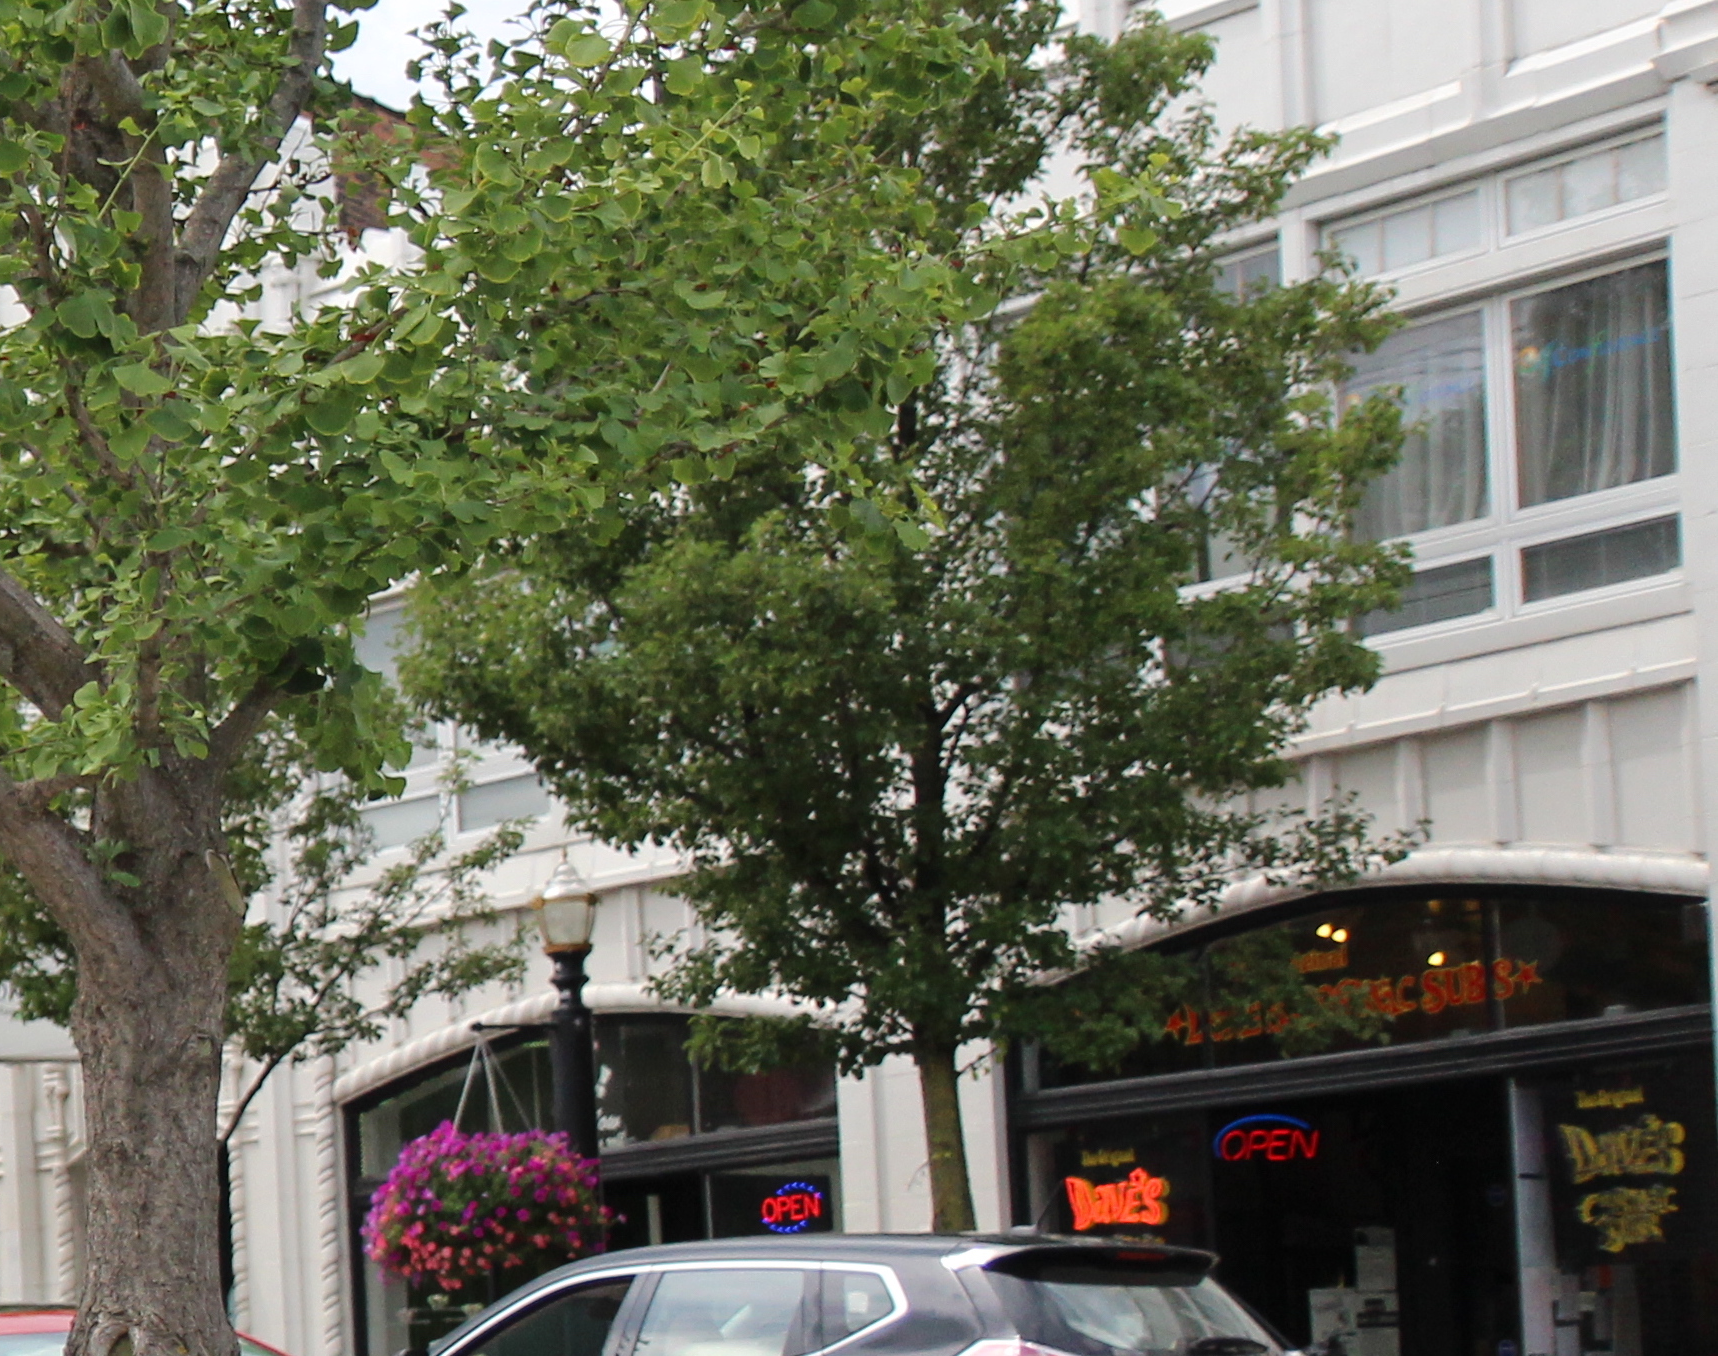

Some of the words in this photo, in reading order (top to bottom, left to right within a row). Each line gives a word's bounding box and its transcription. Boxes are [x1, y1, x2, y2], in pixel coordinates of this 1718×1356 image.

[1420, 957, 1515, 1014] SUBS
[1219, 1128, 1321, 1162] OPEN
[761, 1192, 822, 1223] OPEN
